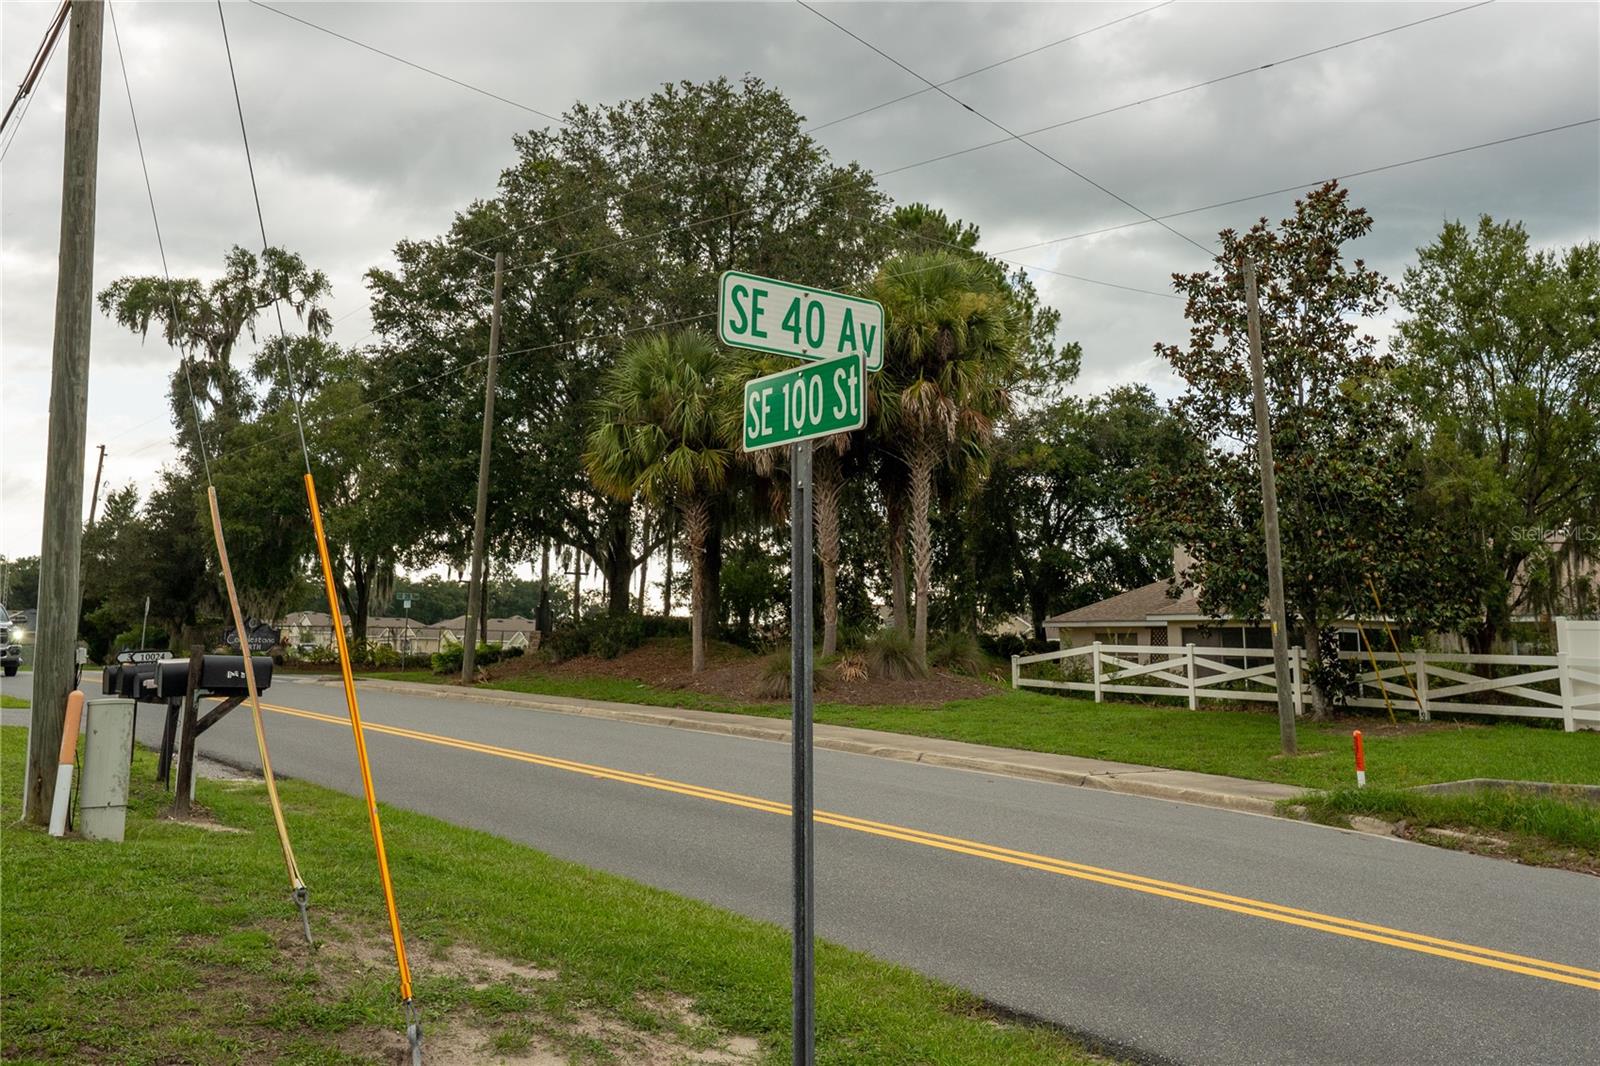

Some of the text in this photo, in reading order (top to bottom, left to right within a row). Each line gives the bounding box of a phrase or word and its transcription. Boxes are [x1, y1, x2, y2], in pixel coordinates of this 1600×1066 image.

[729, 284, 877, 358] SE 40 Av
[747, 365, 858, 439] SE 100 St
[140, 653, 166, 661] 10024
[227, 633, 275, 645] Colestone
